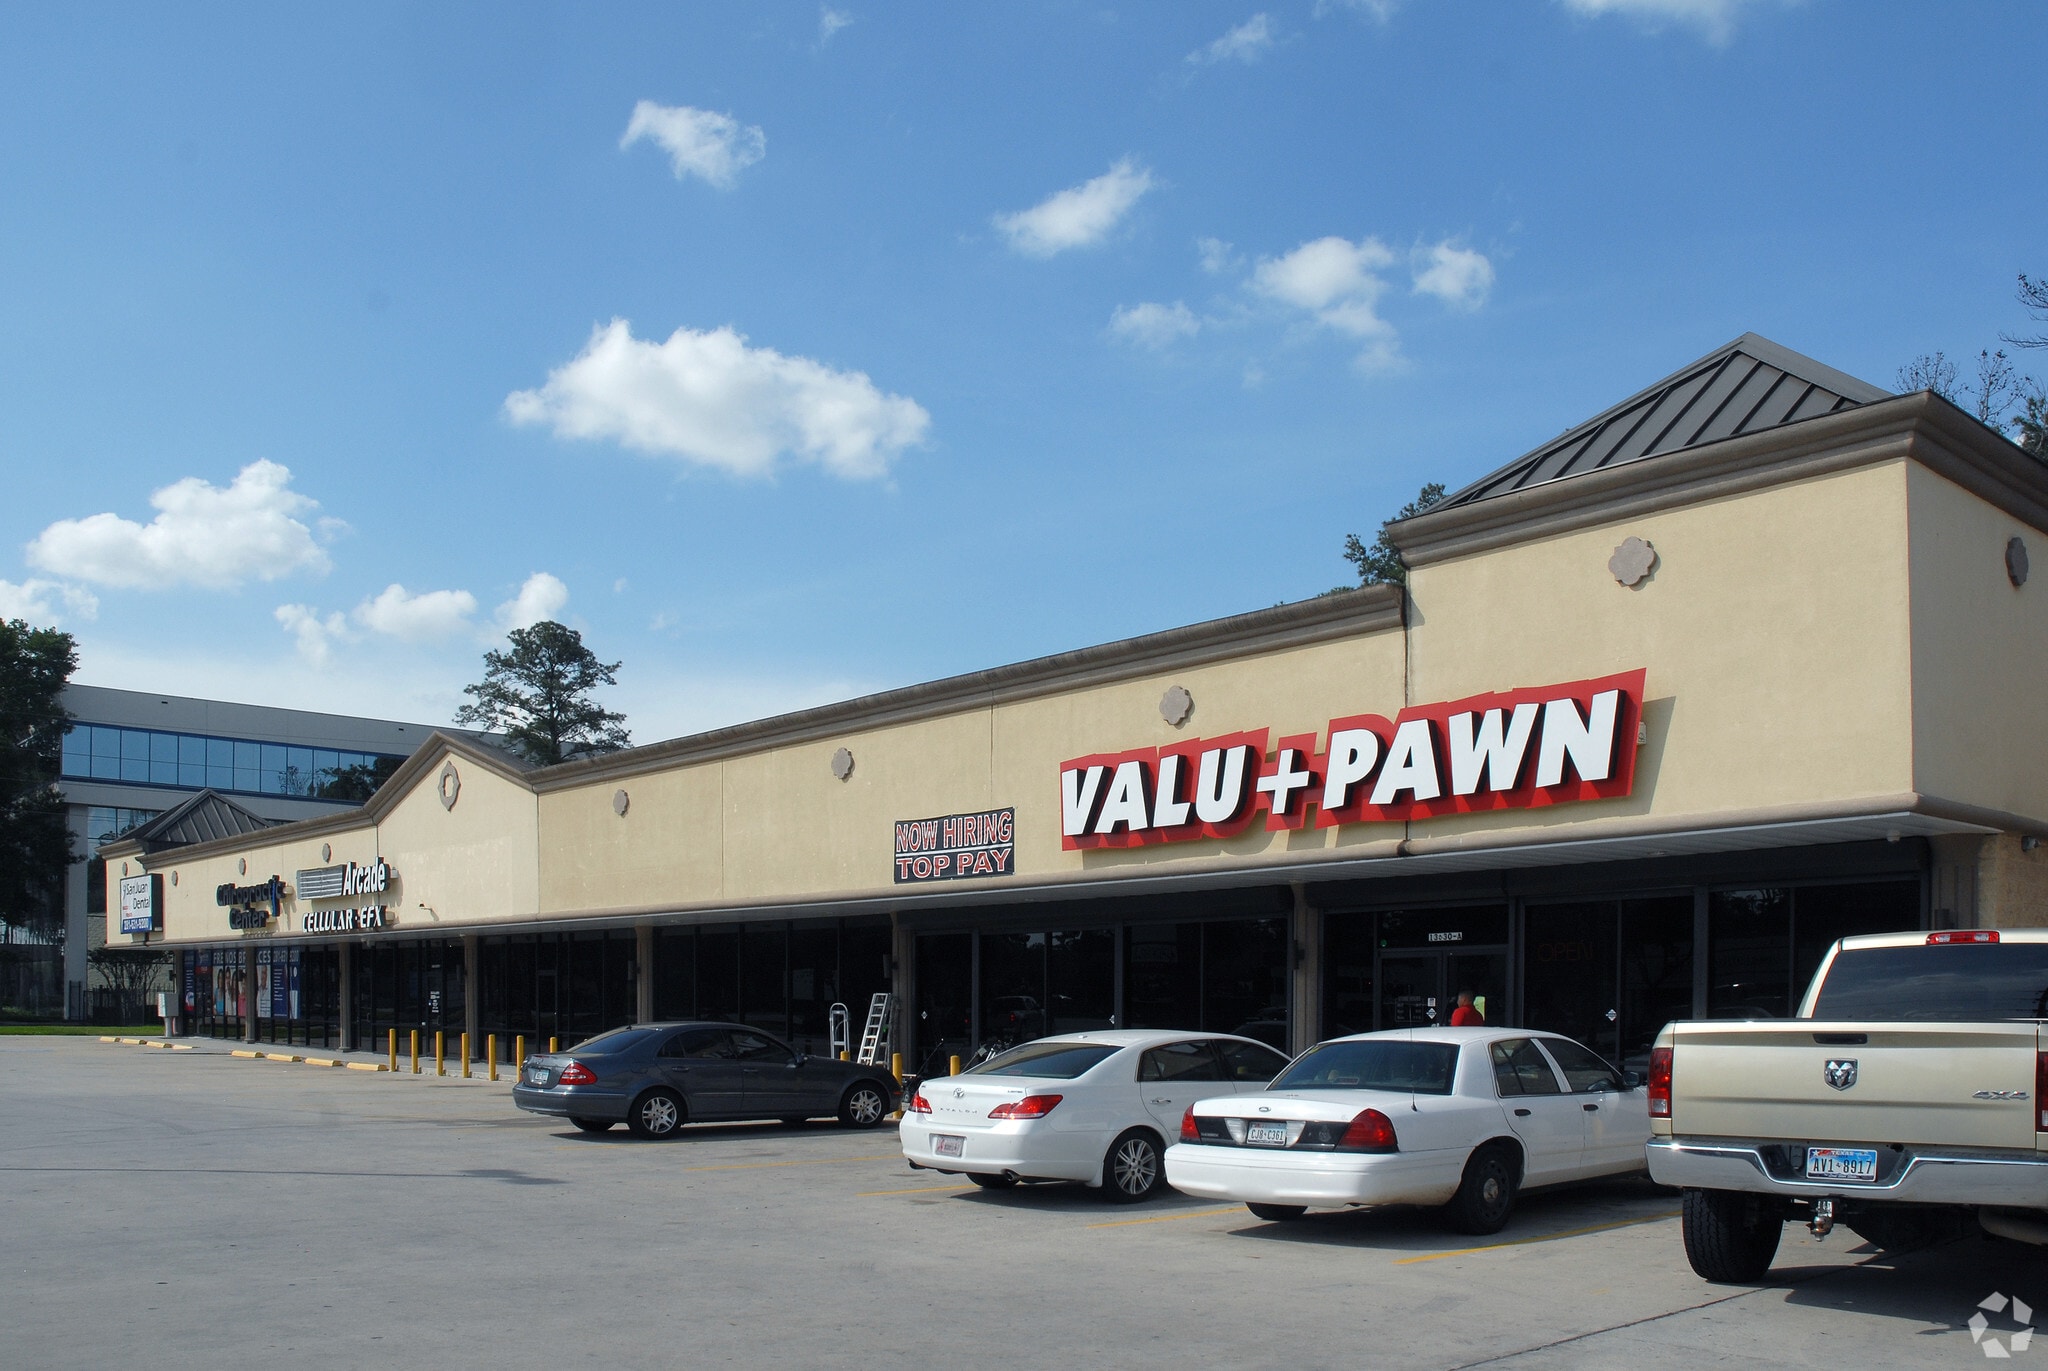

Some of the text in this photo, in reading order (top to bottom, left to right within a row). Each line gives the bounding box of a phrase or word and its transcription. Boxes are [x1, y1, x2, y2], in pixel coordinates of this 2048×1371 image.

[896, 811, 1012, 852] NOW HIRING
[342, 856, 386, 896] Arcade
[896, 848, 1011, 879] TOP PAY
[229, 908, 268, 930] Center
